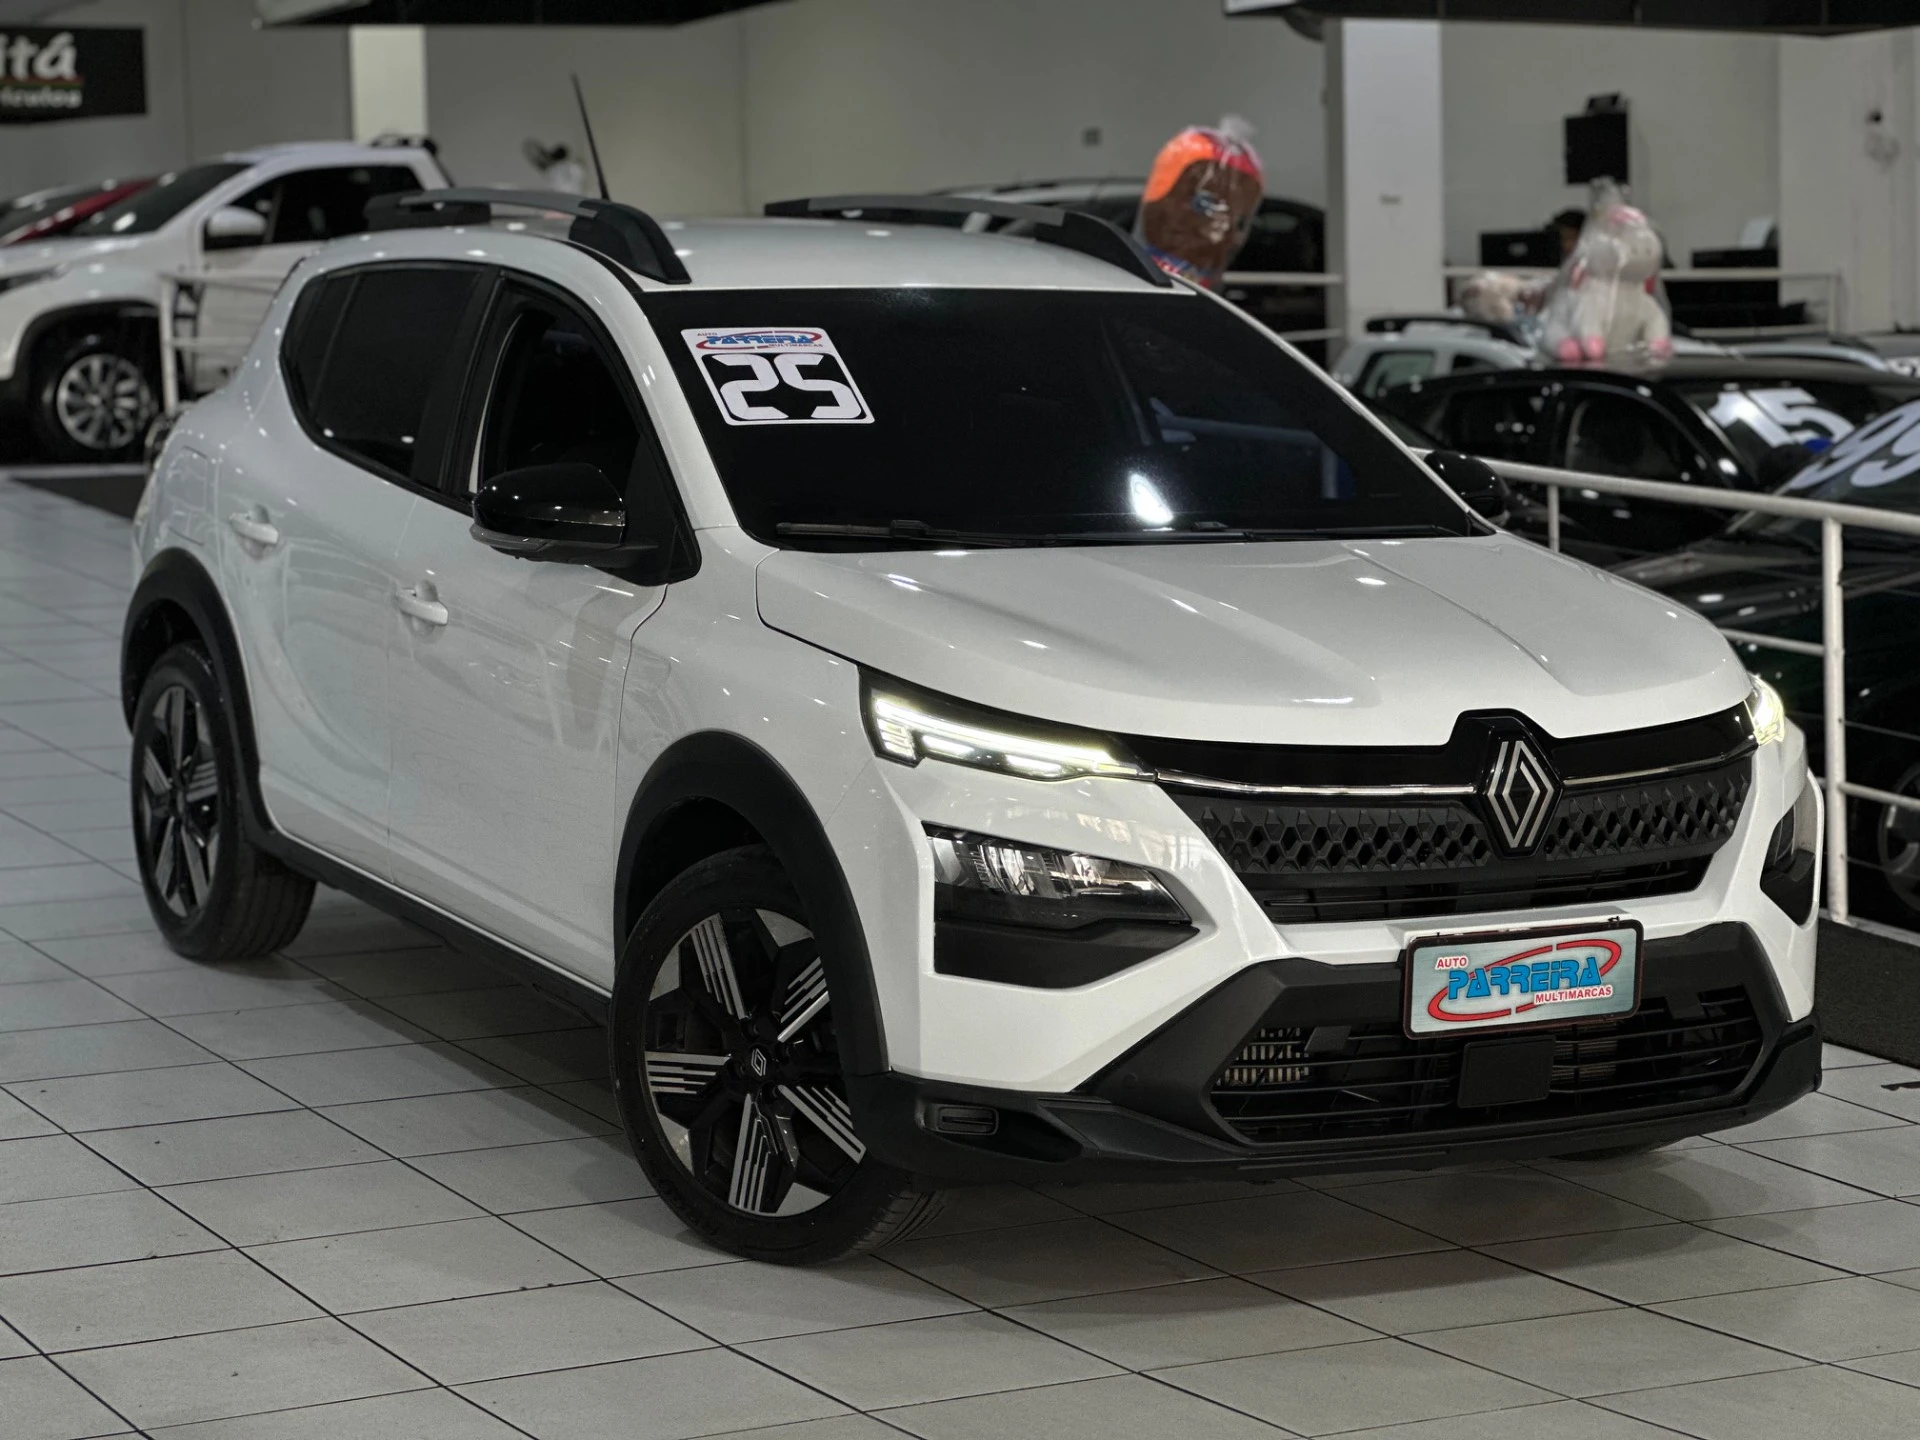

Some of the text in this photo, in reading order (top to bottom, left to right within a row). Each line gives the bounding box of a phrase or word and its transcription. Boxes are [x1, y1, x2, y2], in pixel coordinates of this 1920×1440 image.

[711, 353, 862, 420] 25
[1708, 387, 1856, 449] 15
[1436, 956, 1468, 970] AUTO
[1448, 956, 1602, 1000] PARREIRA
[1535, 986, 1612, 1004] MULTIMARCAS
